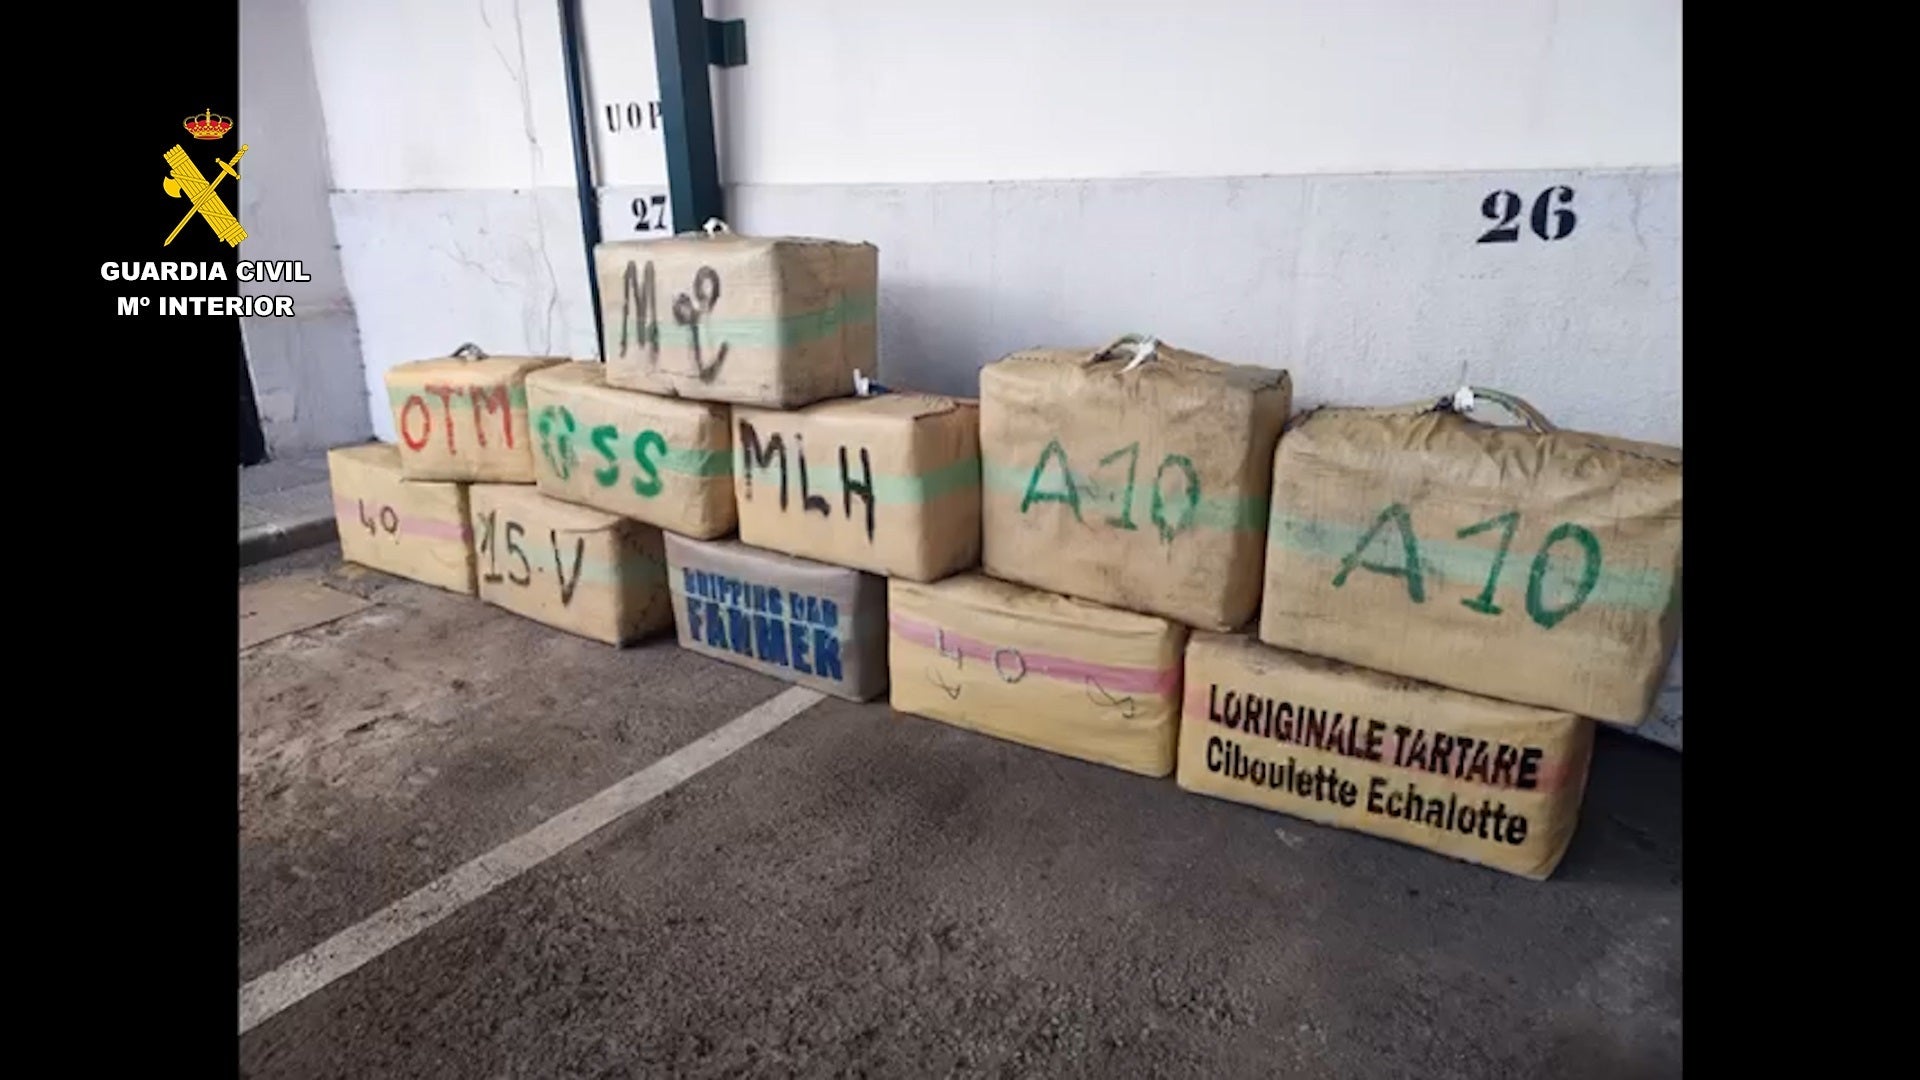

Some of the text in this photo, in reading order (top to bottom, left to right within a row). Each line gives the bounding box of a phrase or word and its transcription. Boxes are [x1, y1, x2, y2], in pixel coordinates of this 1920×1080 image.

[631, 195, 667, 232] 27
[1476, 185, 1577, 243] 26
[401, 384, 514, 455] OTM
[359, 499, 398, 536] 40
[740, 418, 875, 543] MLH
[1021, 439, 1202, 546] A10
[1331, 502, 1602, 629] A10
[1208, 684, 1387, 763] LORIGINALE
[1393, 725, 1543, 790] TARTARE
[1206, 736, 1528, 845] Ciboulette Echalotte
